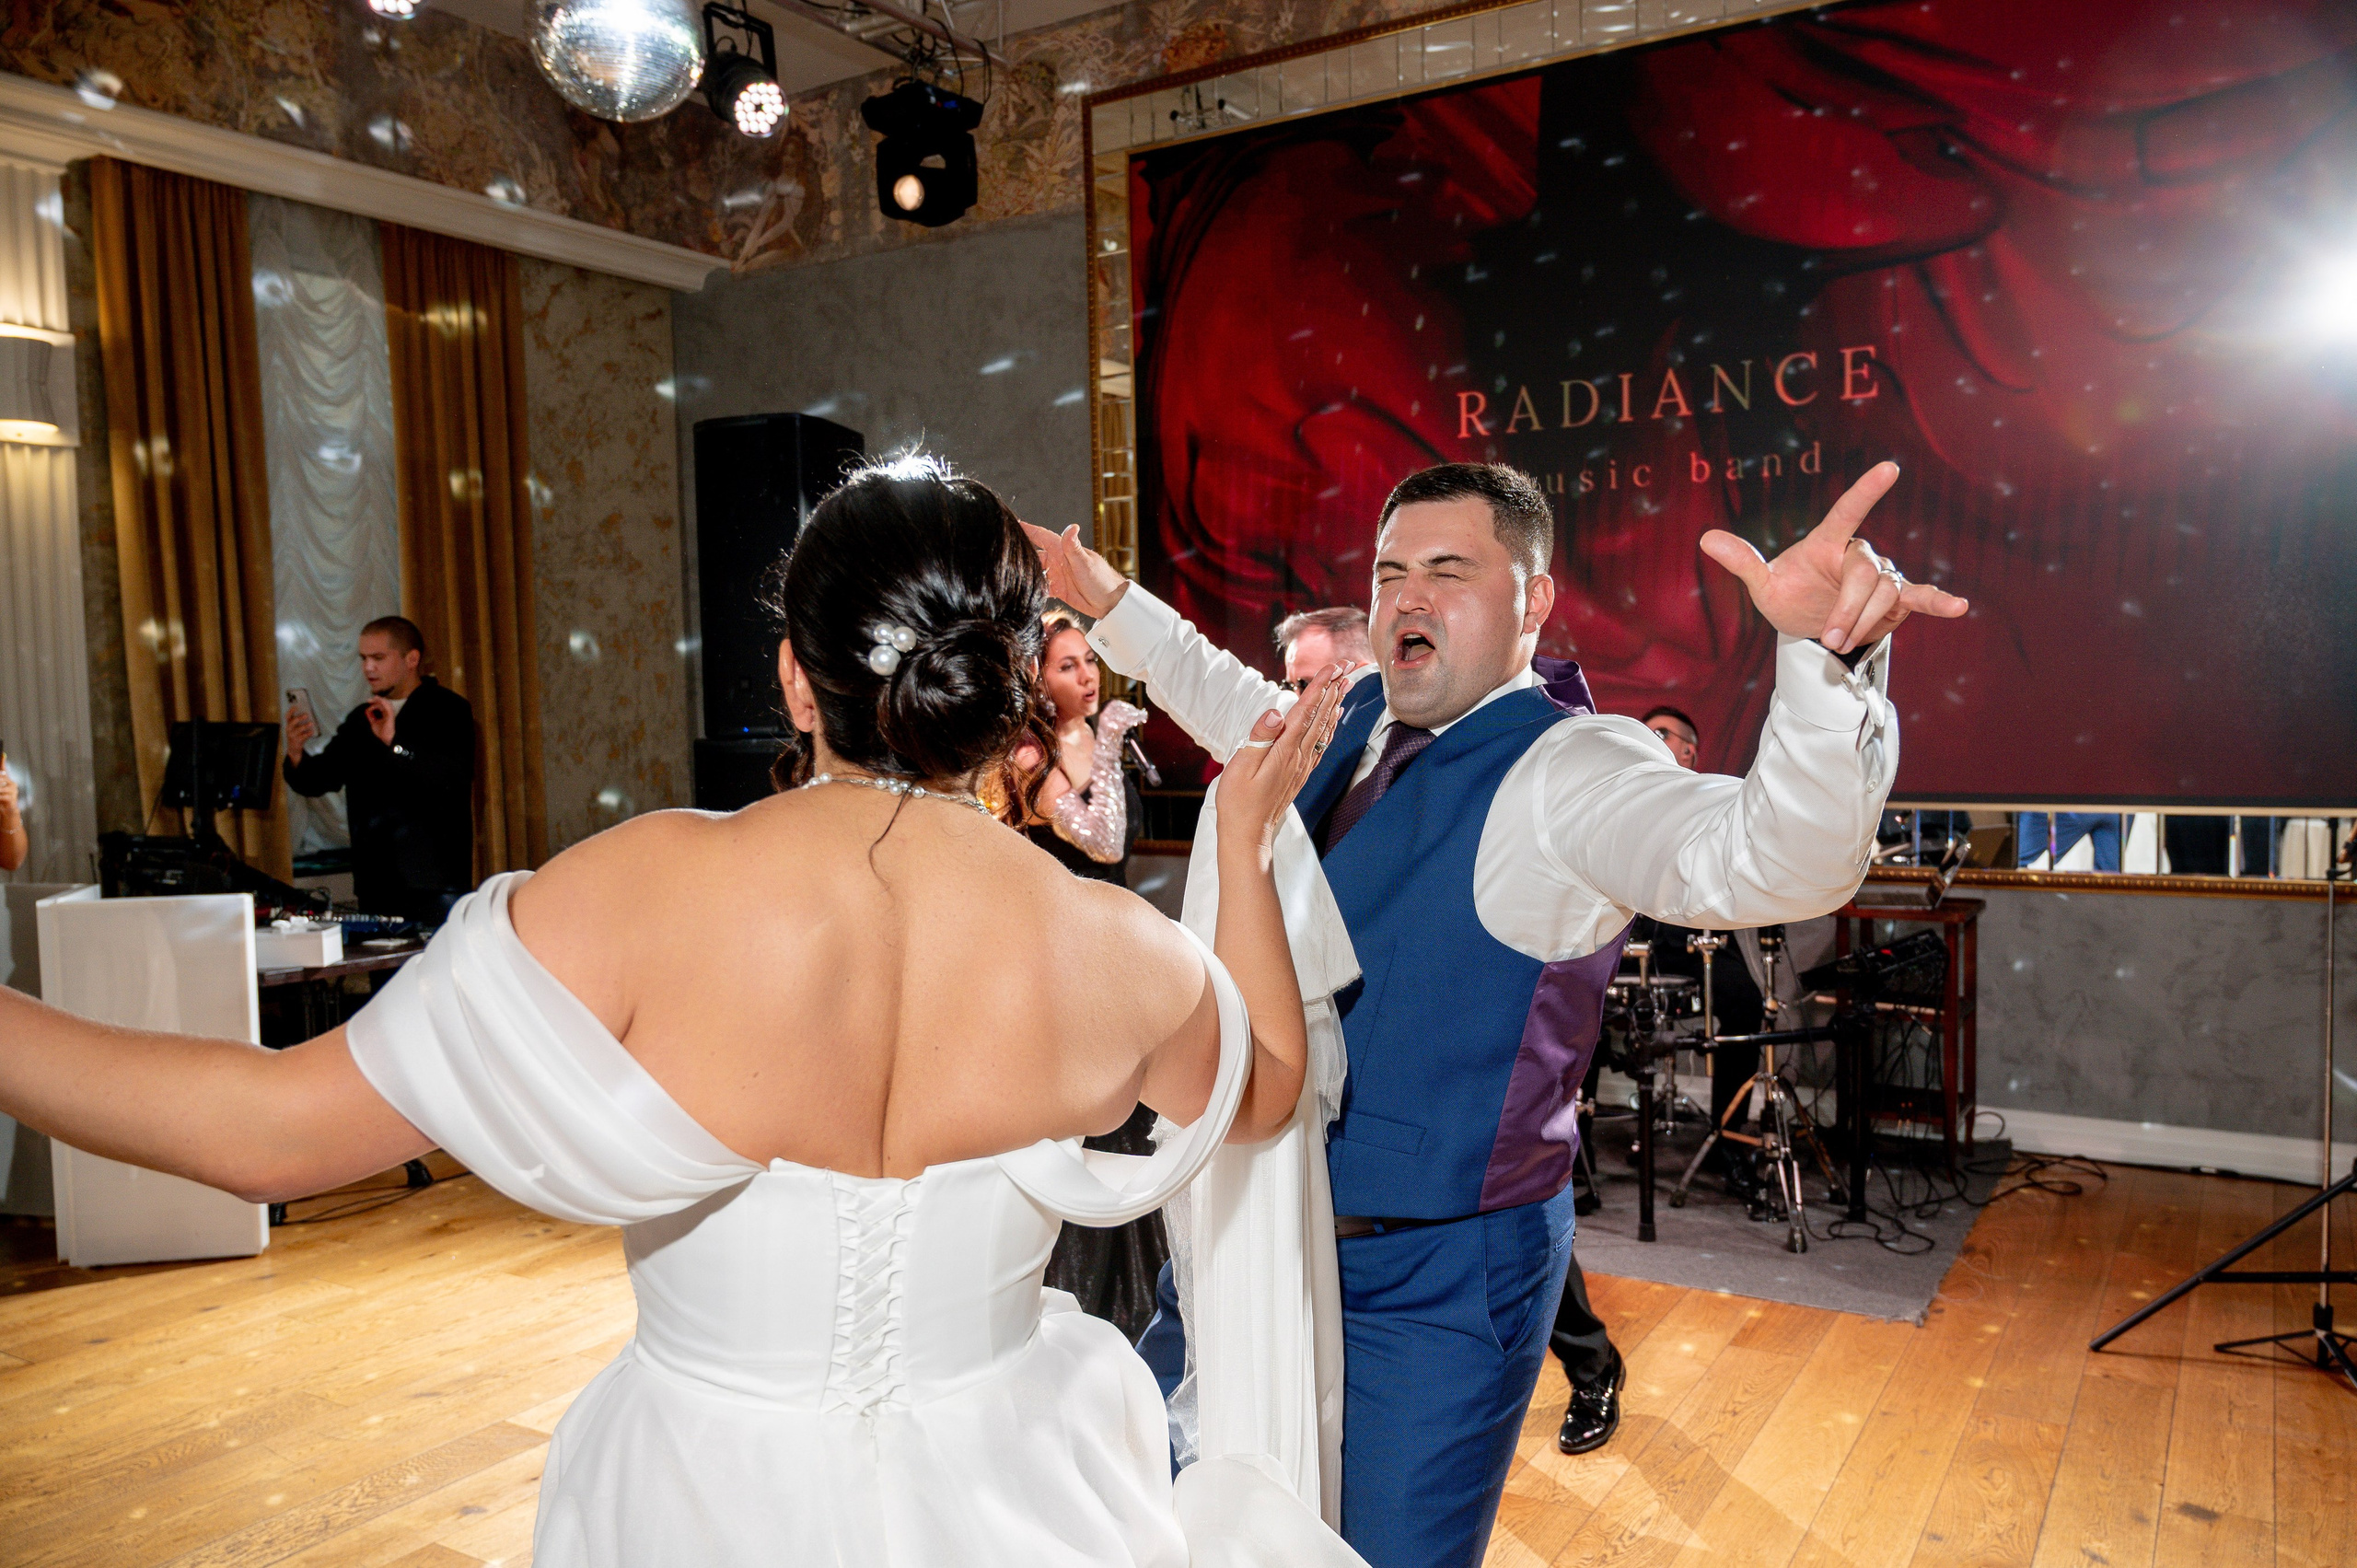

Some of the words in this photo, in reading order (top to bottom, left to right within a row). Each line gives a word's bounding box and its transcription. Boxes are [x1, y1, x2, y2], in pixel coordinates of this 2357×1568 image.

[1457, 345, 1879, 438] RADIANCE
[1545, 459, 1652, 494] usic
[1690, 442, 1823, 483] band
